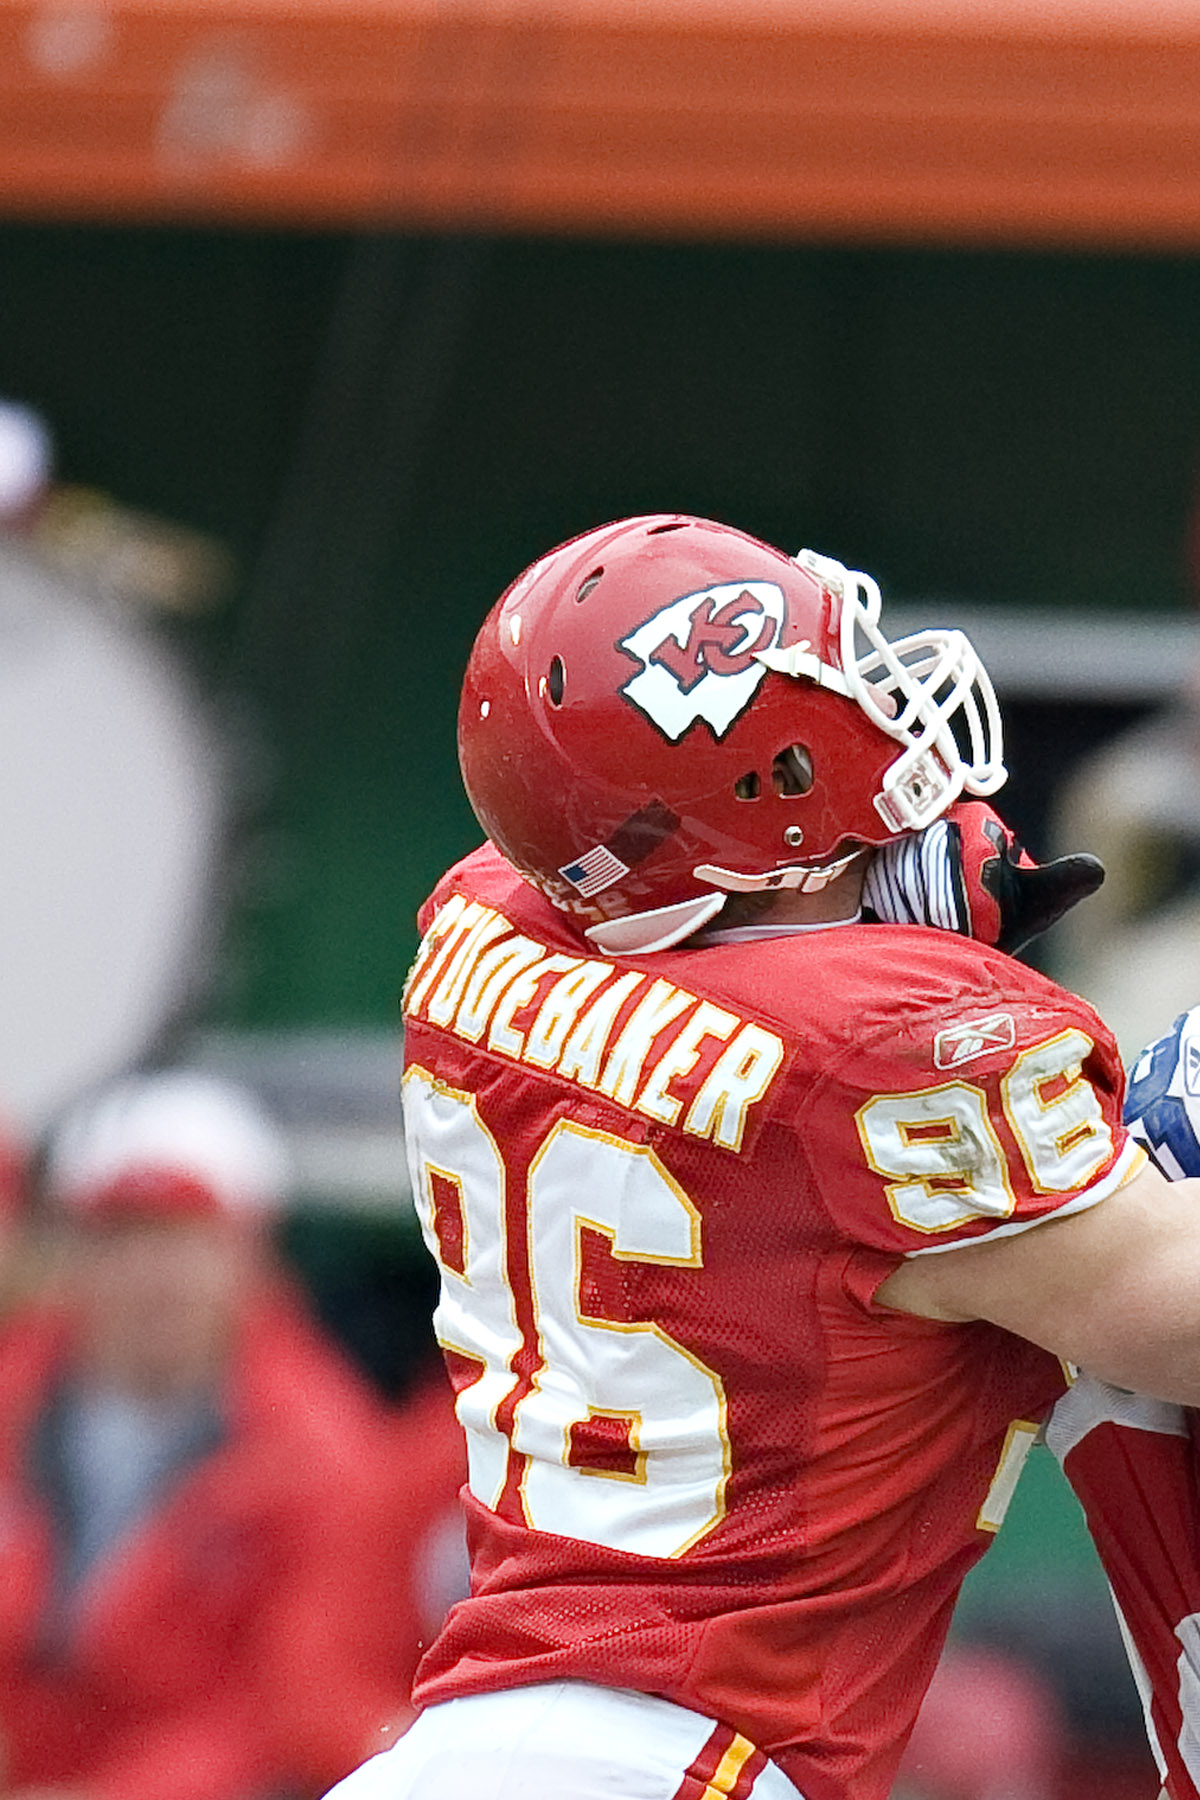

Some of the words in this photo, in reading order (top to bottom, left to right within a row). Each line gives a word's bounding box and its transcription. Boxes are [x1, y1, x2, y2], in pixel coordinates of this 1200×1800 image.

[649, 590, 777, 695] KC
[854, 1027, 1116, 1235] 96
[402, 1062, 732, 1560] 96
